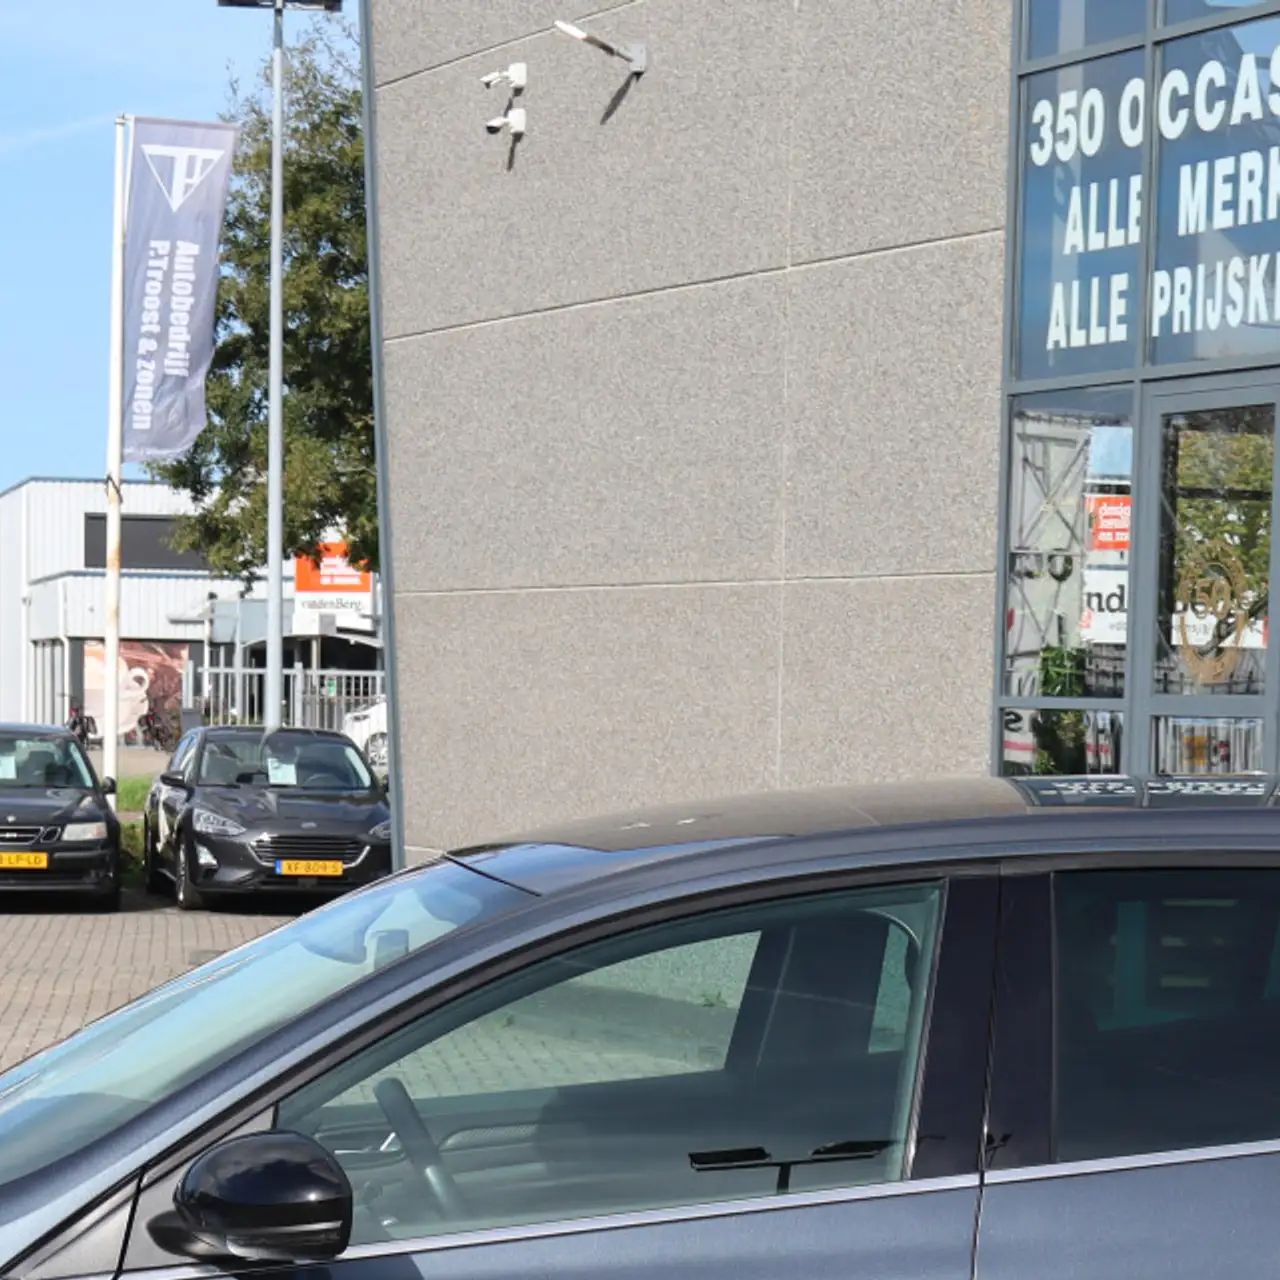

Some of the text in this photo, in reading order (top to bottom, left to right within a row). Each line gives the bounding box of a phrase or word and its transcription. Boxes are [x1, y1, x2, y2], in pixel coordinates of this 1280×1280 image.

[1030, 87, 1105, 166] 350
[1063, 173, 1143, 255] ALLE
[163, 240, 201, 377] Autobedrijf
[1046, 272, 1129, 350] ALLE
[131, 361, 154, 430] zonen
